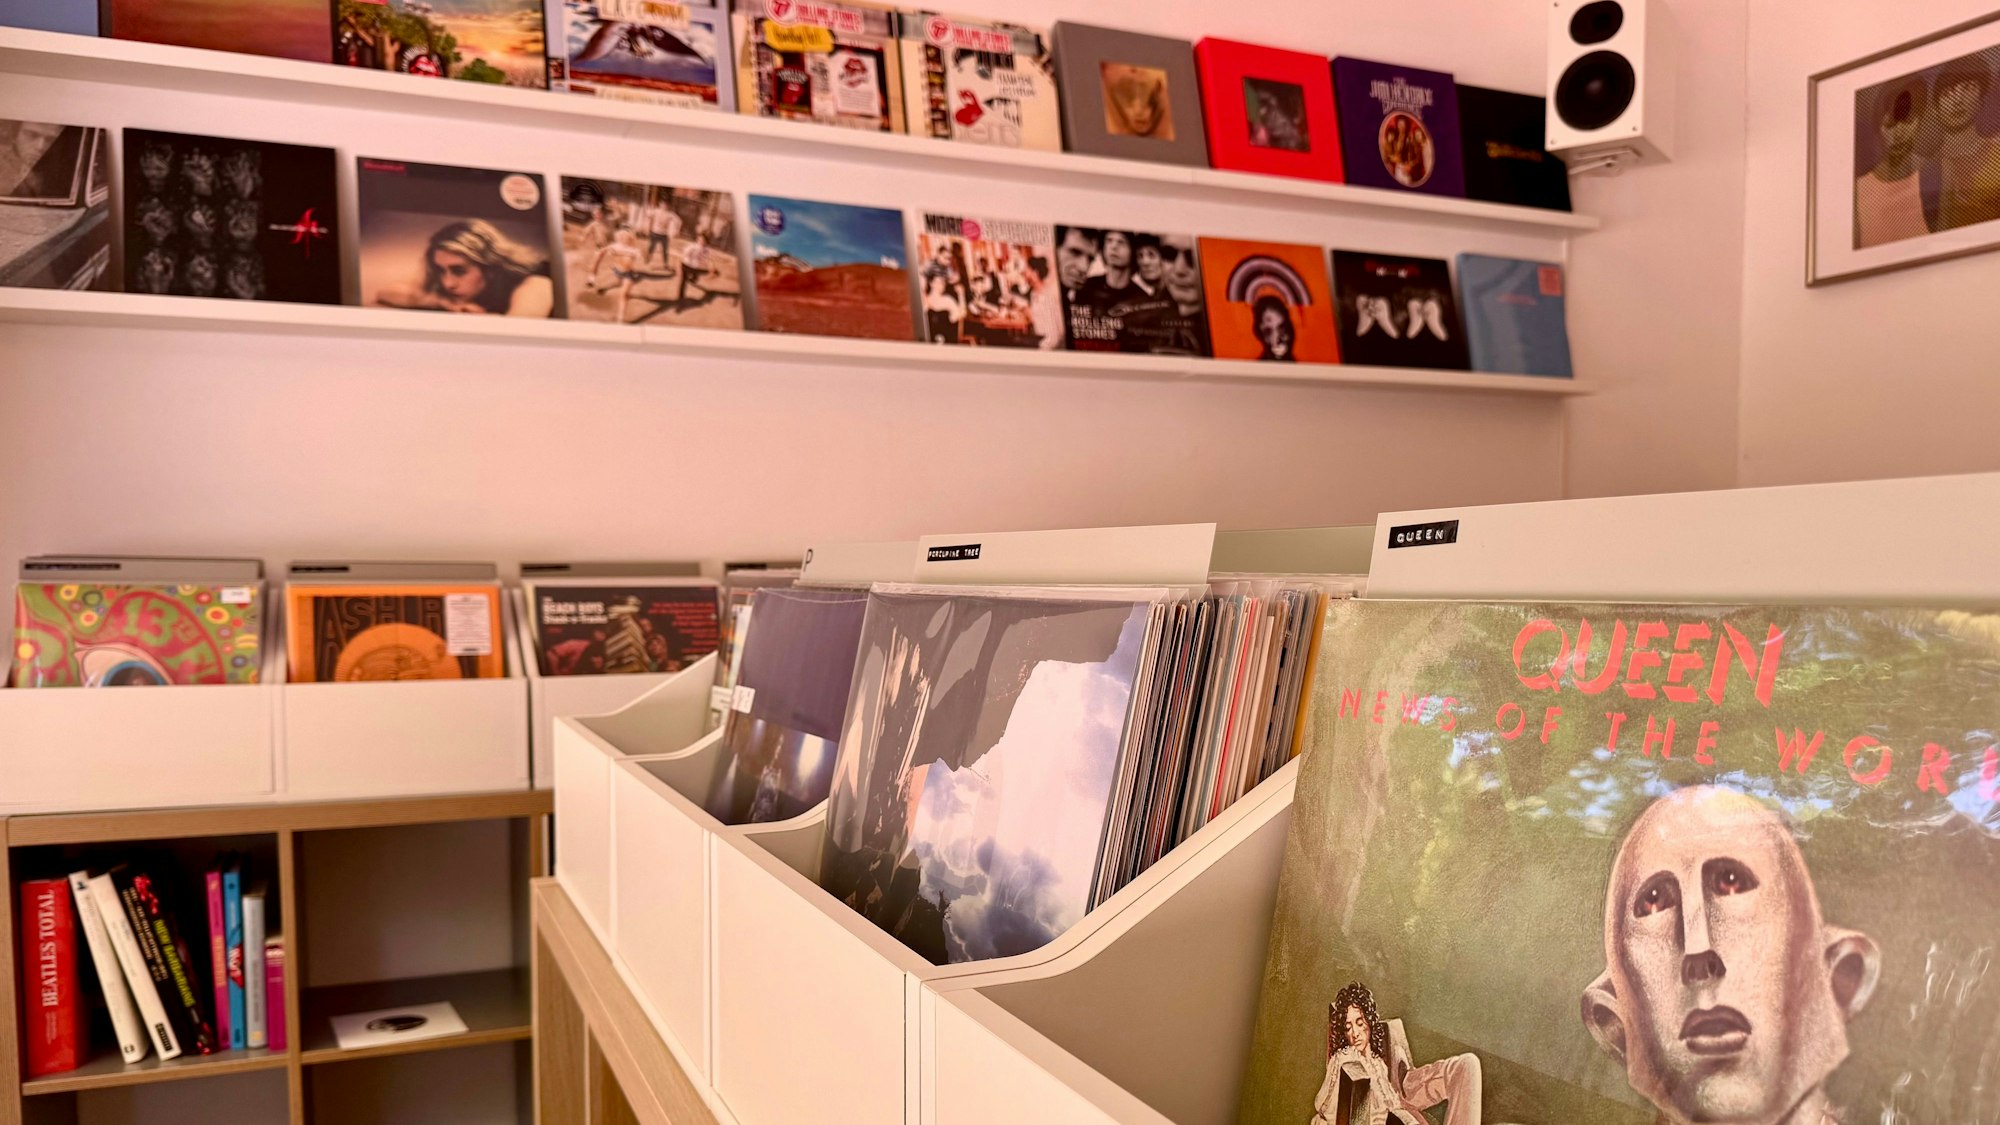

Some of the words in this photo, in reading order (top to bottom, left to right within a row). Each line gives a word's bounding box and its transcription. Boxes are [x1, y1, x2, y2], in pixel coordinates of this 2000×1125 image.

[1070, 304, 1092, 318] THE
[1071, 316, 1124, 330] ROLLING
[1073, 328, 1117, 340] STONES
[1397, 529, 1444, 543] QUEEN
[803, 549, 814, 572] P
[928, 549, 960, 559] PORCUPINE
[964, 547, 979, 557] TREE
[1512, 618, 1785, 708] QUEEN
[1338, 687, 1459, 732] NEWS
[1495, 702, 1563, 744] OF
[1604, 711, 1721, 765] THE
[37, 889, 57, 939] TOTAL
[153, 919, 171, 945] NEW
[39, 941, 60, 1007] BEATLES
